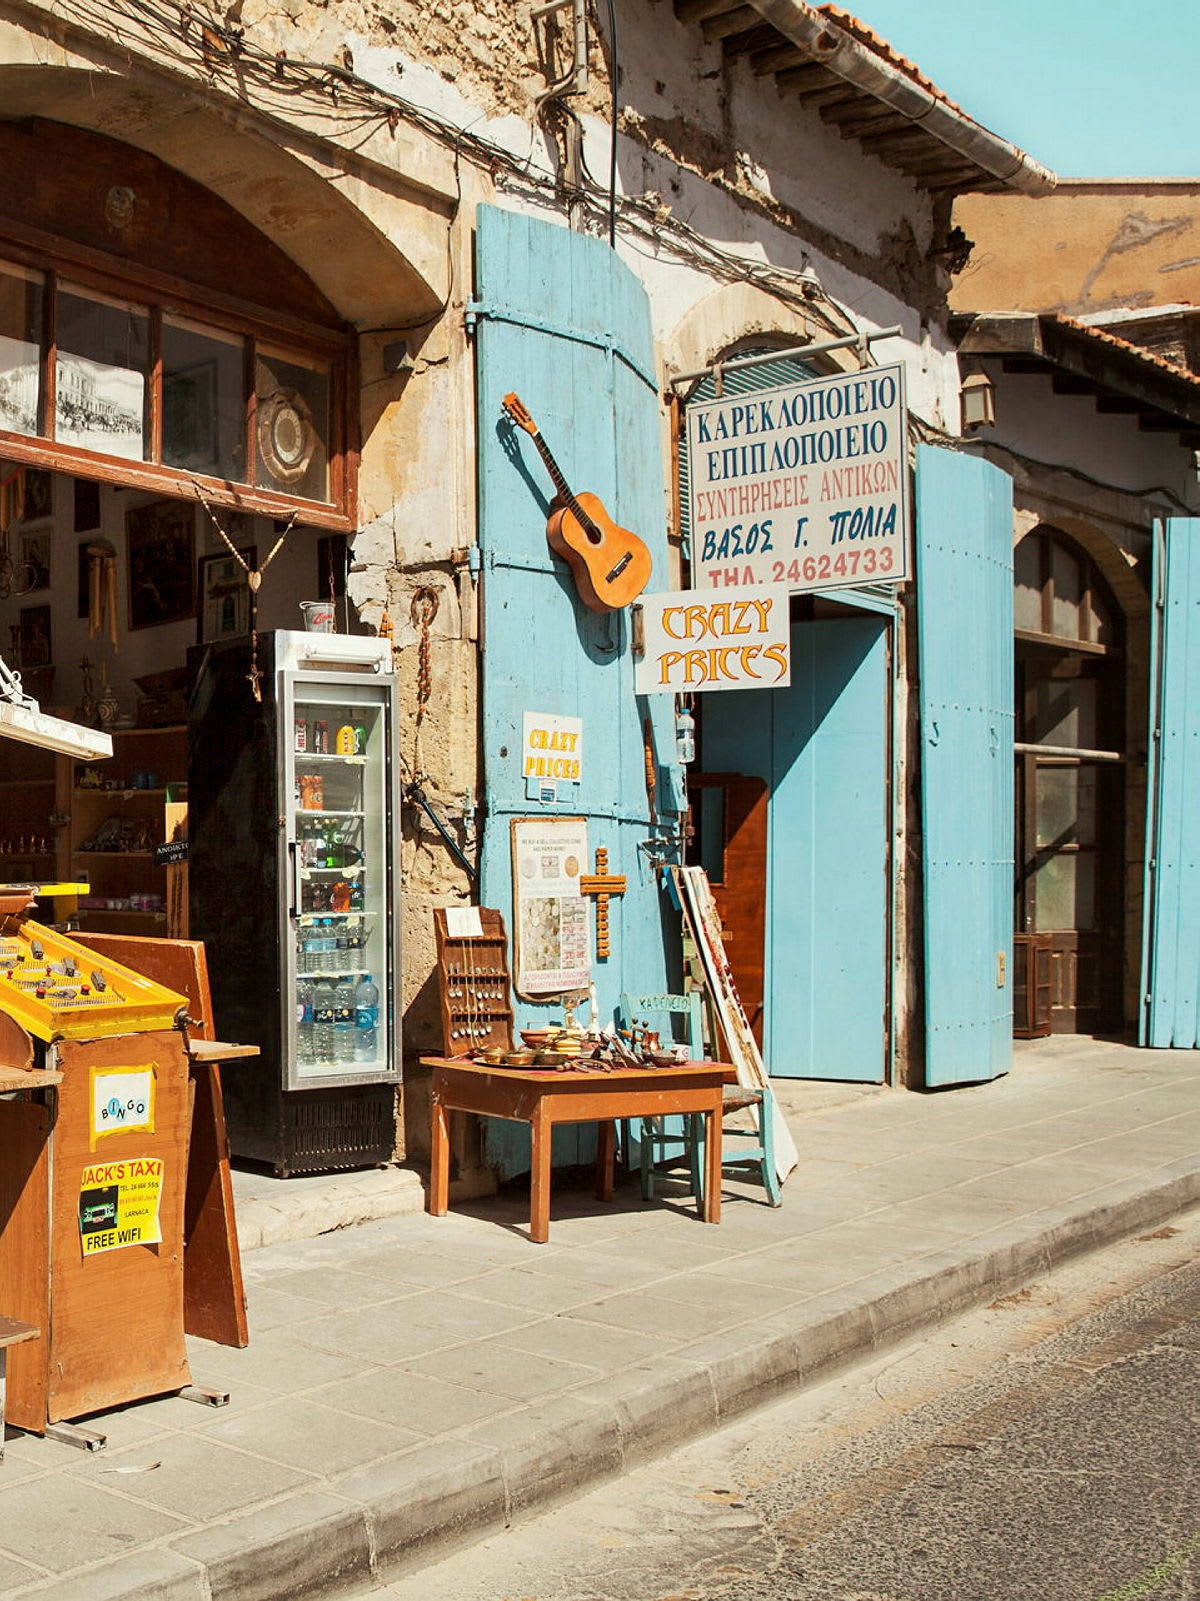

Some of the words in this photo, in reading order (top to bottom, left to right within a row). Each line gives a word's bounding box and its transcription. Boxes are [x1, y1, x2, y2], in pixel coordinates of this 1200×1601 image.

[696, 375, 897, 444] ΚΑΡΕΚΛΟΠΟΙΕΙΟ
[707, 420, 887, 482] ΕΠΙΠΛΟΠΟΙΕΙΟ
[696, 474, 809, 522] ΣΥΝΤΗΡΗΣΕΙΣ
[820, 459, 899, 503] ΑΝΤΙΚΩΝ
[701, 519, 774, 562] ΒΑΣΟΣ
[794, 517, 809, 548] Γ.
[708, 564, 763, 588] ΤΗΛ.
[772, 546, 894, 584] 24624733
[662, 597, 774, 642] CRAZY
[657, 643, 788, 688] PRICES
[529, 728, 579, 752] CRAZY
[525, 756, 580, 778] PRICES
[101, 1097, 145, 1120] BINGO
[81, 1164, 125, 1186] JACK'S
[129, 1161, 163, 1177] TAXI
[86, 1232, 115, 1250] FREE
[117, 1227, 141, 1244] WIFI
